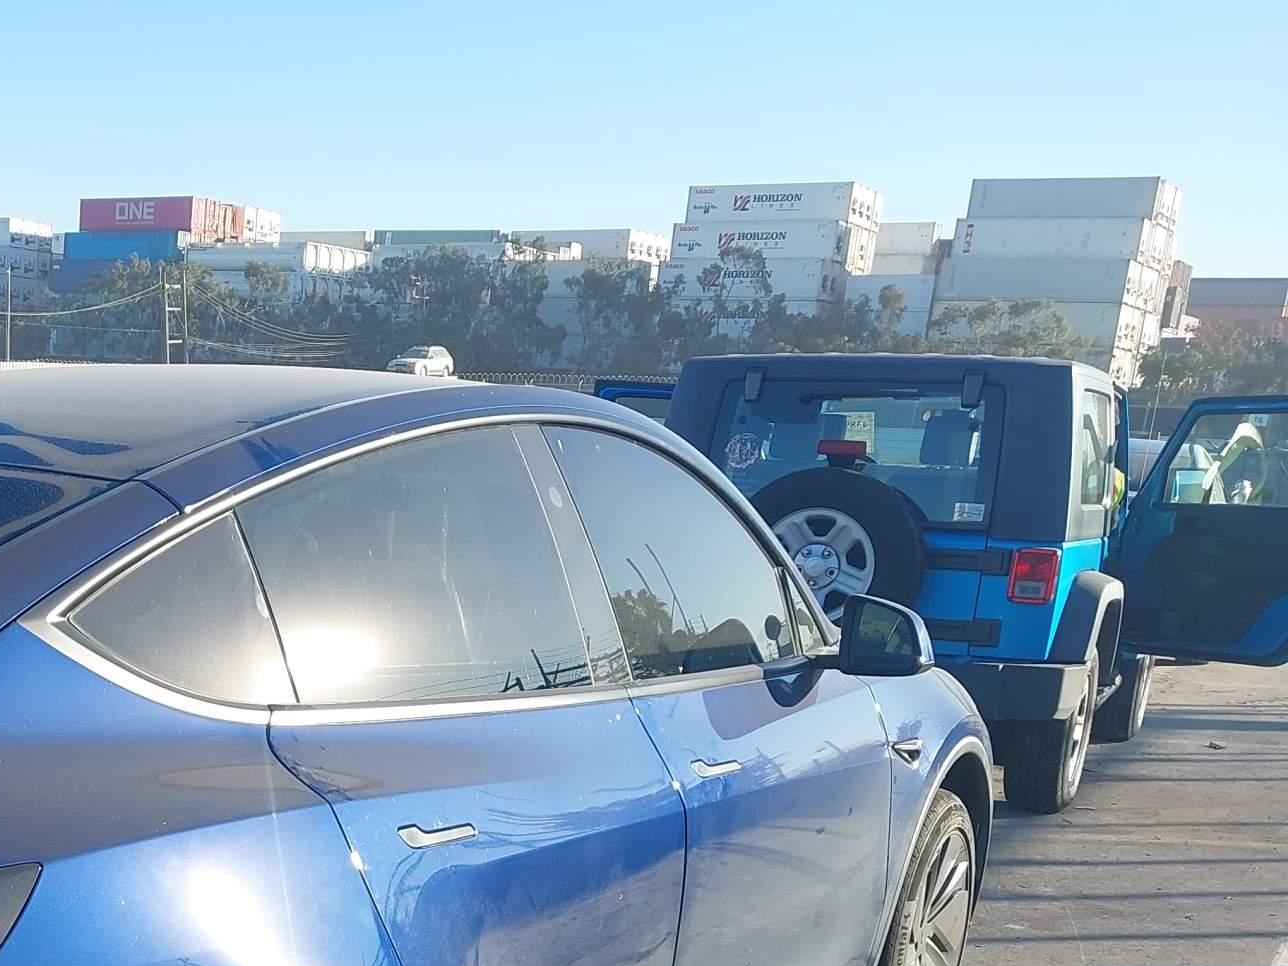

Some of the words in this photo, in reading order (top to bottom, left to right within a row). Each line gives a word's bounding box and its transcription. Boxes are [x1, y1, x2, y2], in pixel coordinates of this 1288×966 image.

[752, 193, 802, 203] HORIZON
[115, 201, 155, 220] ONE
[737, 231, 787, 241] HORIZON
[723, 270, 773, 279] HORIZON
